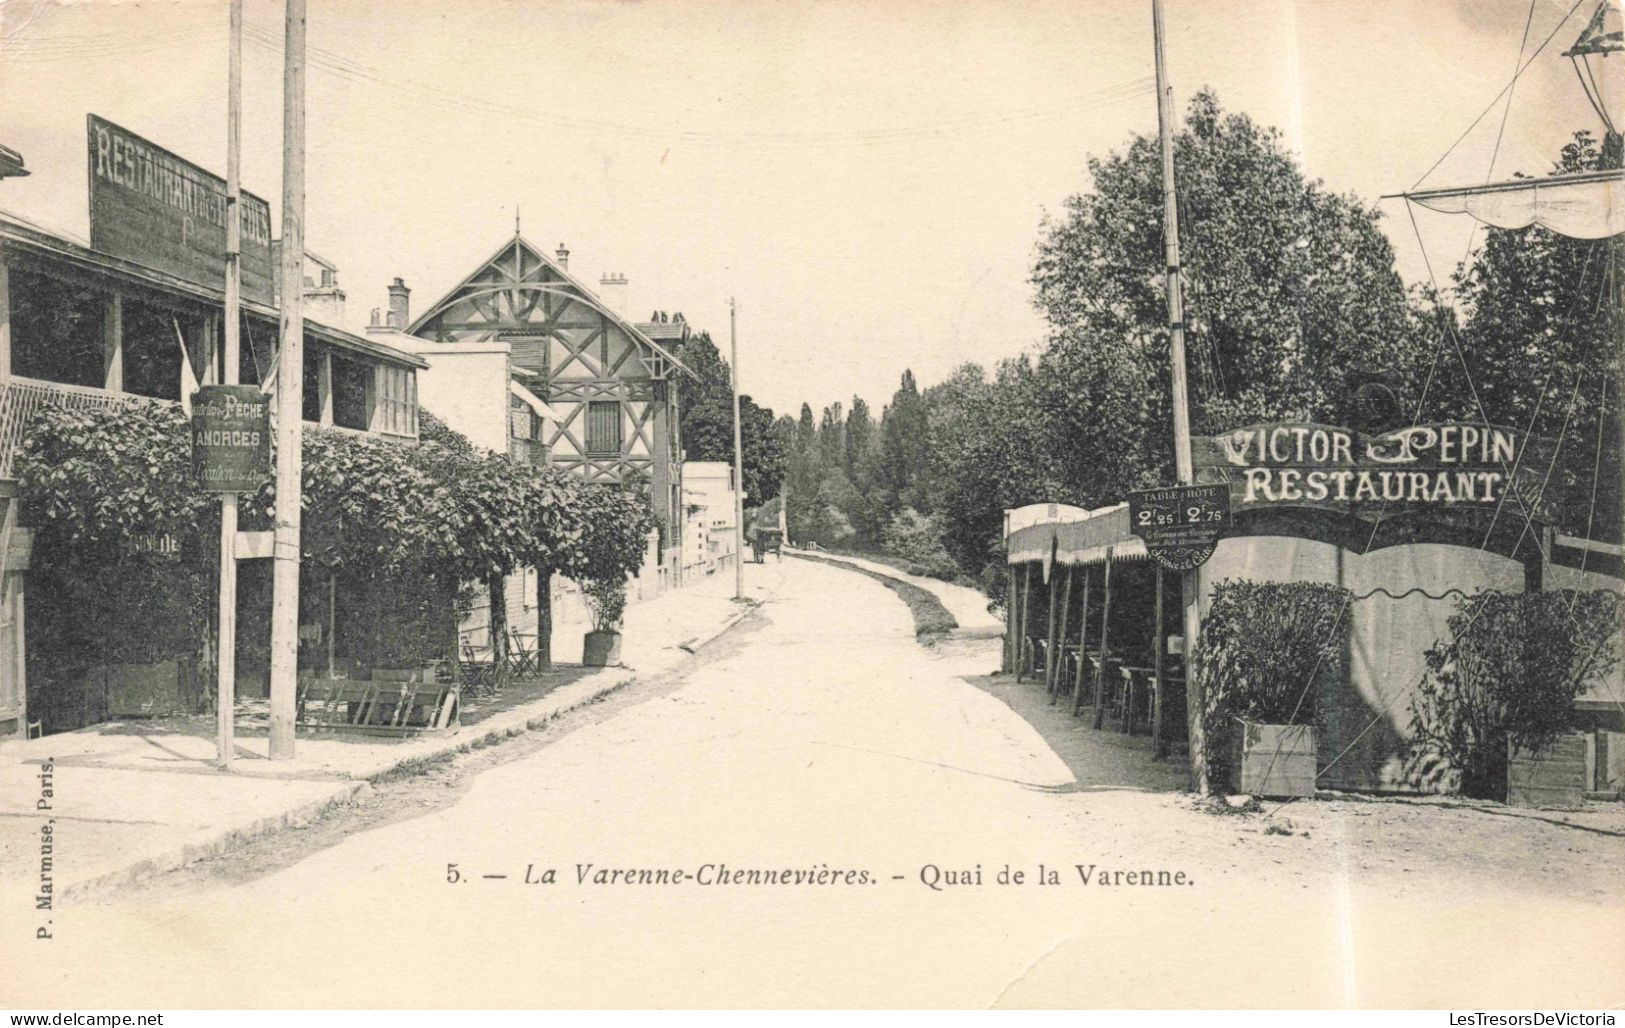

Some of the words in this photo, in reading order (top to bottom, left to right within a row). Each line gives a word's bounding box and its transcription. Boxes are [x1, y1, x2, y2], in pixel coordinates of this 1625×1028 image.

[95, 125, 200, 217] RESTAURANT
[195, 430, 260, 446] AMORCES
[1213, 427, 1355, 466] VICTOR
[1143, 491, 1178, 502] TABLE
[1243, 468, 1501, 502] RESTAURANT
[1151, 548, 1178, 570] Service
